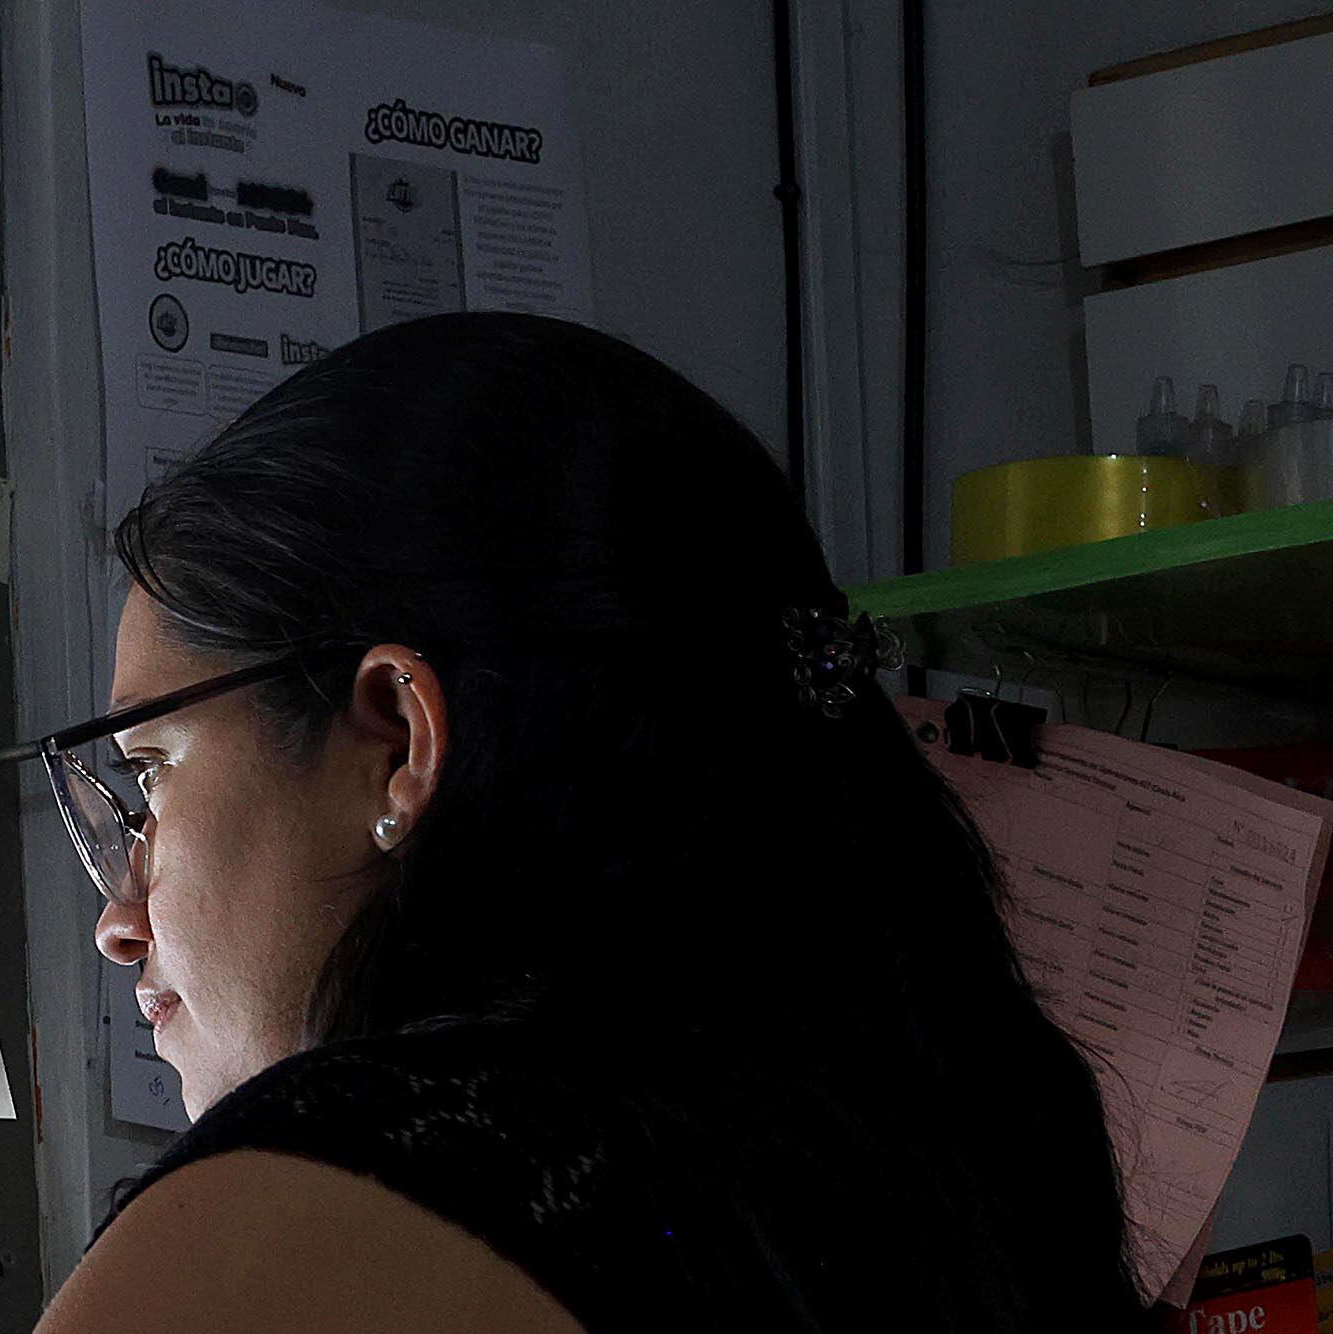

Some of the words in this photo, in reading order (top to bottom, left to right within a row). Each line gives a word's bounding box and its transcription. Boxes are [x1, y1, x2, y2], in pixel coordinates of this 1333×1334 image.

[155, 113, 171, 126] La
[365, 98, 445, 150] ¿CÓMO
[446, 117, 542, 163] GANAR?
[155, 237, 235, 284] ¿CÓMO
[234, 252, 317, 298] JUGAR?
